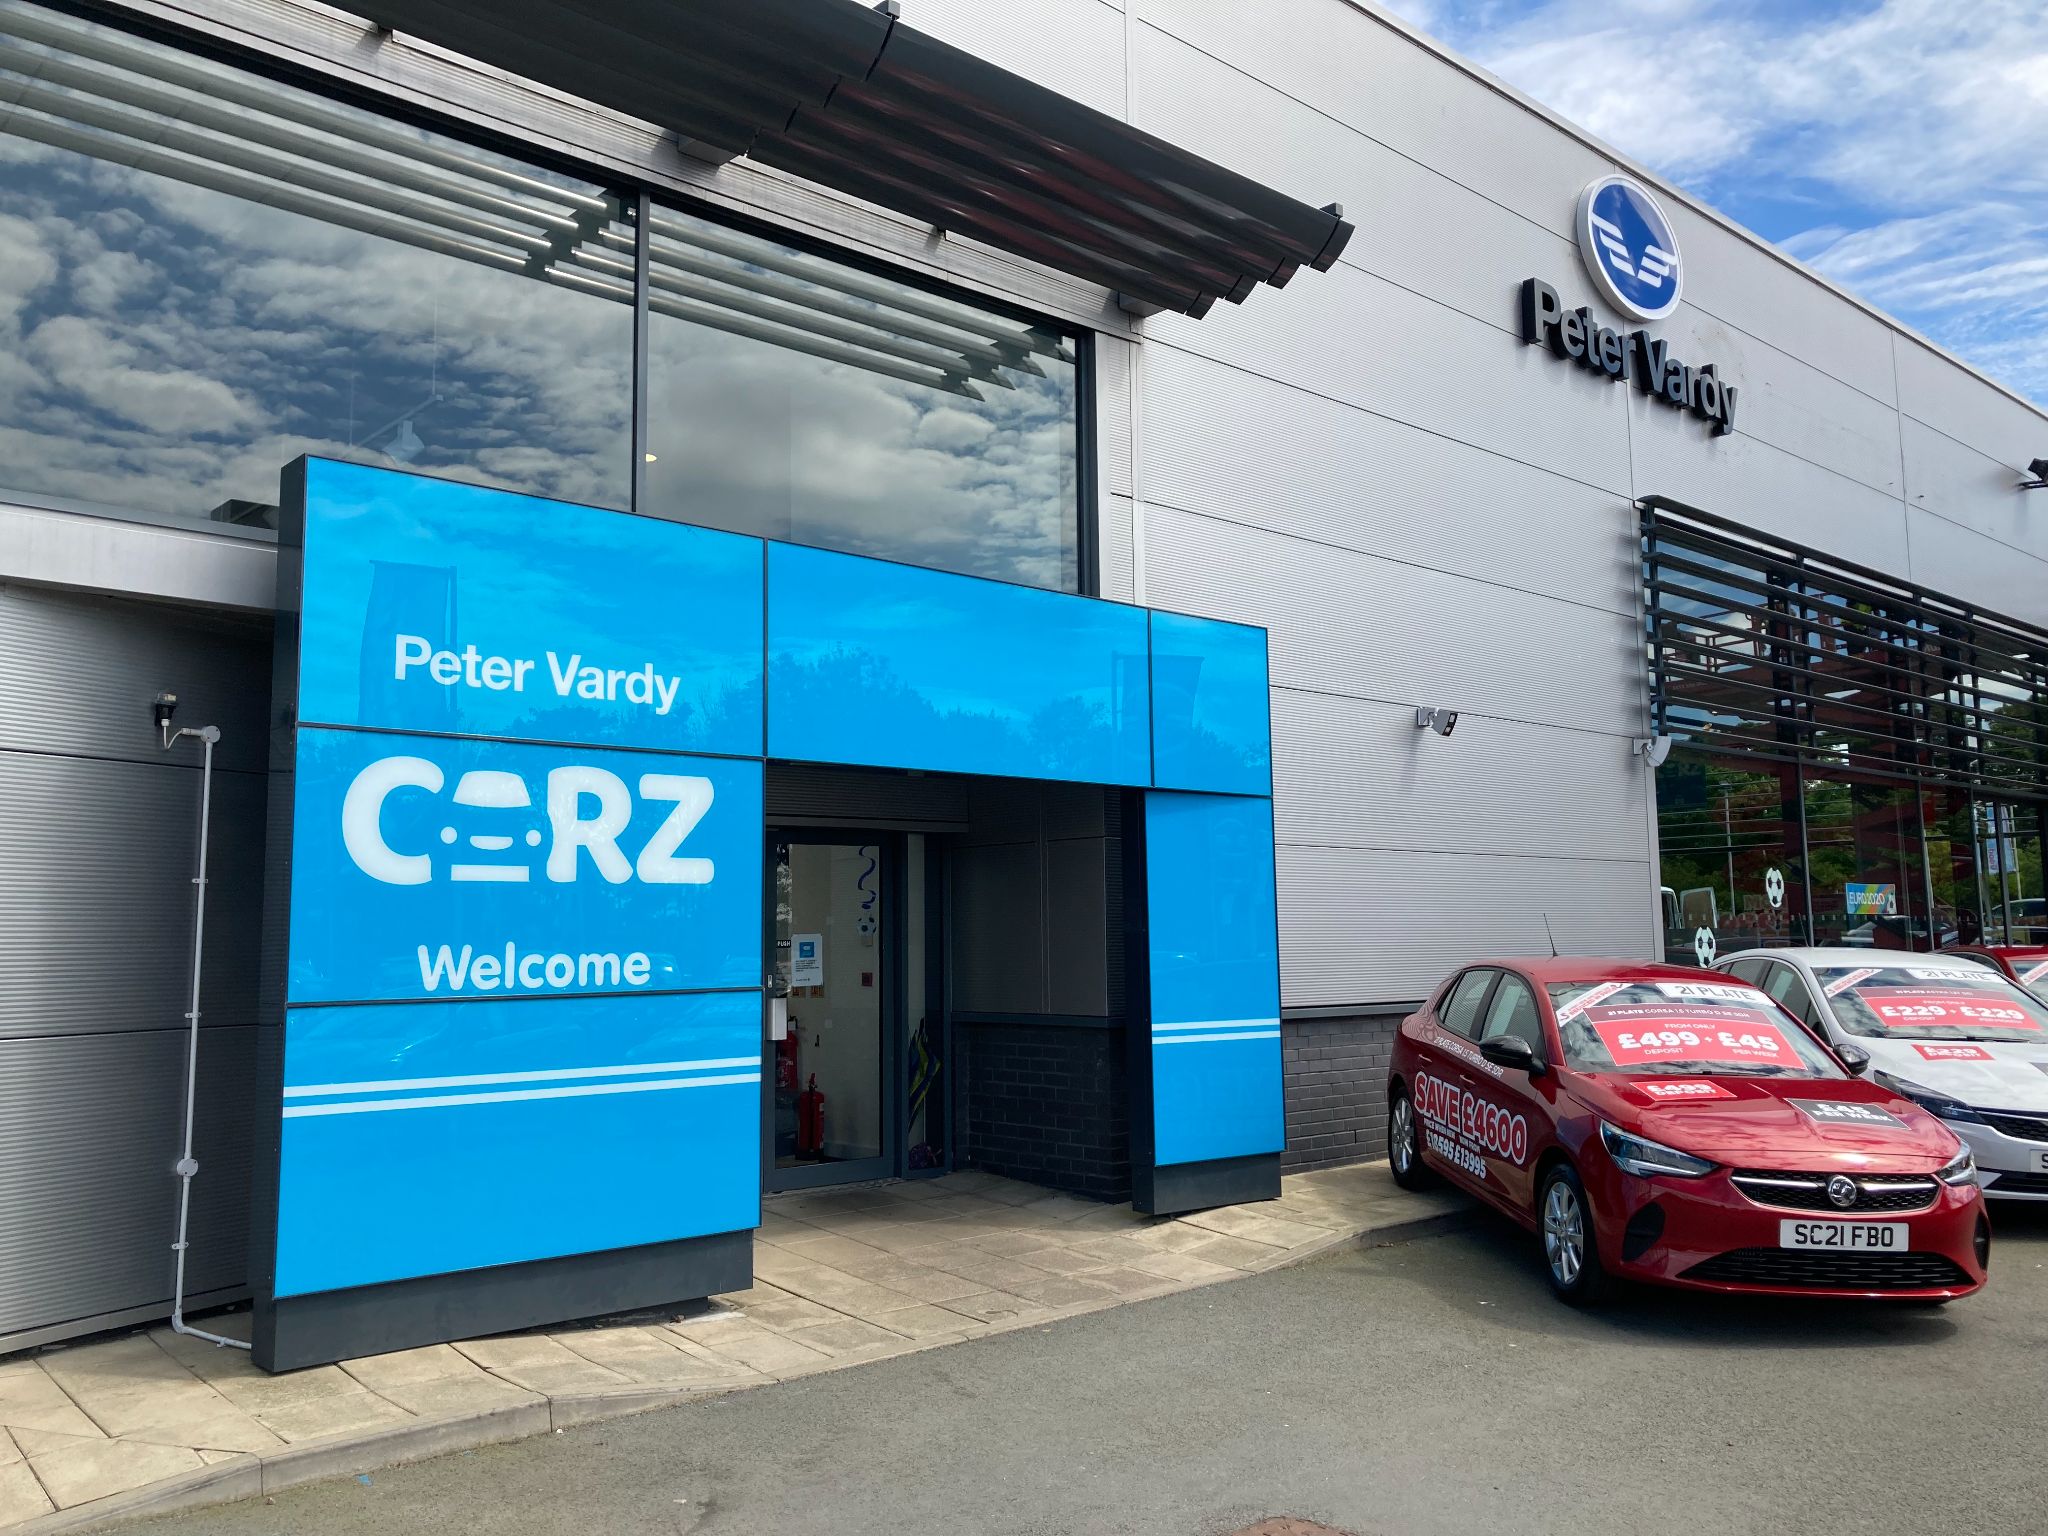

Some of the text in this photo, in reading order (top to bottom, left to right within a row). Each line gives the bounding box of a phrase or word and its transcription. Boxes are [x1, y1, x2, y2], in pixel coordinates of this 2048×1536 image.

[1523, 277, 1738, 436] Peter Vardy
[394, 633, 681, 716] Peter Vardy
[341, 755, 715, 886] CARZ
[417, 941, 651, 992] Welcome
[1940, 969, 1991, 980] PLATE
[1698, 986, 1756, 1001] PLATE
[1880, 1005, 1946, 1017] £229
[1959, 1006, 2025, 1020] £229
[1618, 1031, 1700, 1049] £499
[1717, 1031, 1779, 1051] £45
[1644, 1047, 1684, 1055] DEPOSIT
[1414, 1071, 1527, 1165] SAVE £4600
[1454, 1144, 1487, 1179] £13995
[1794, 1223, 1894, 1248] SC21 FBO
